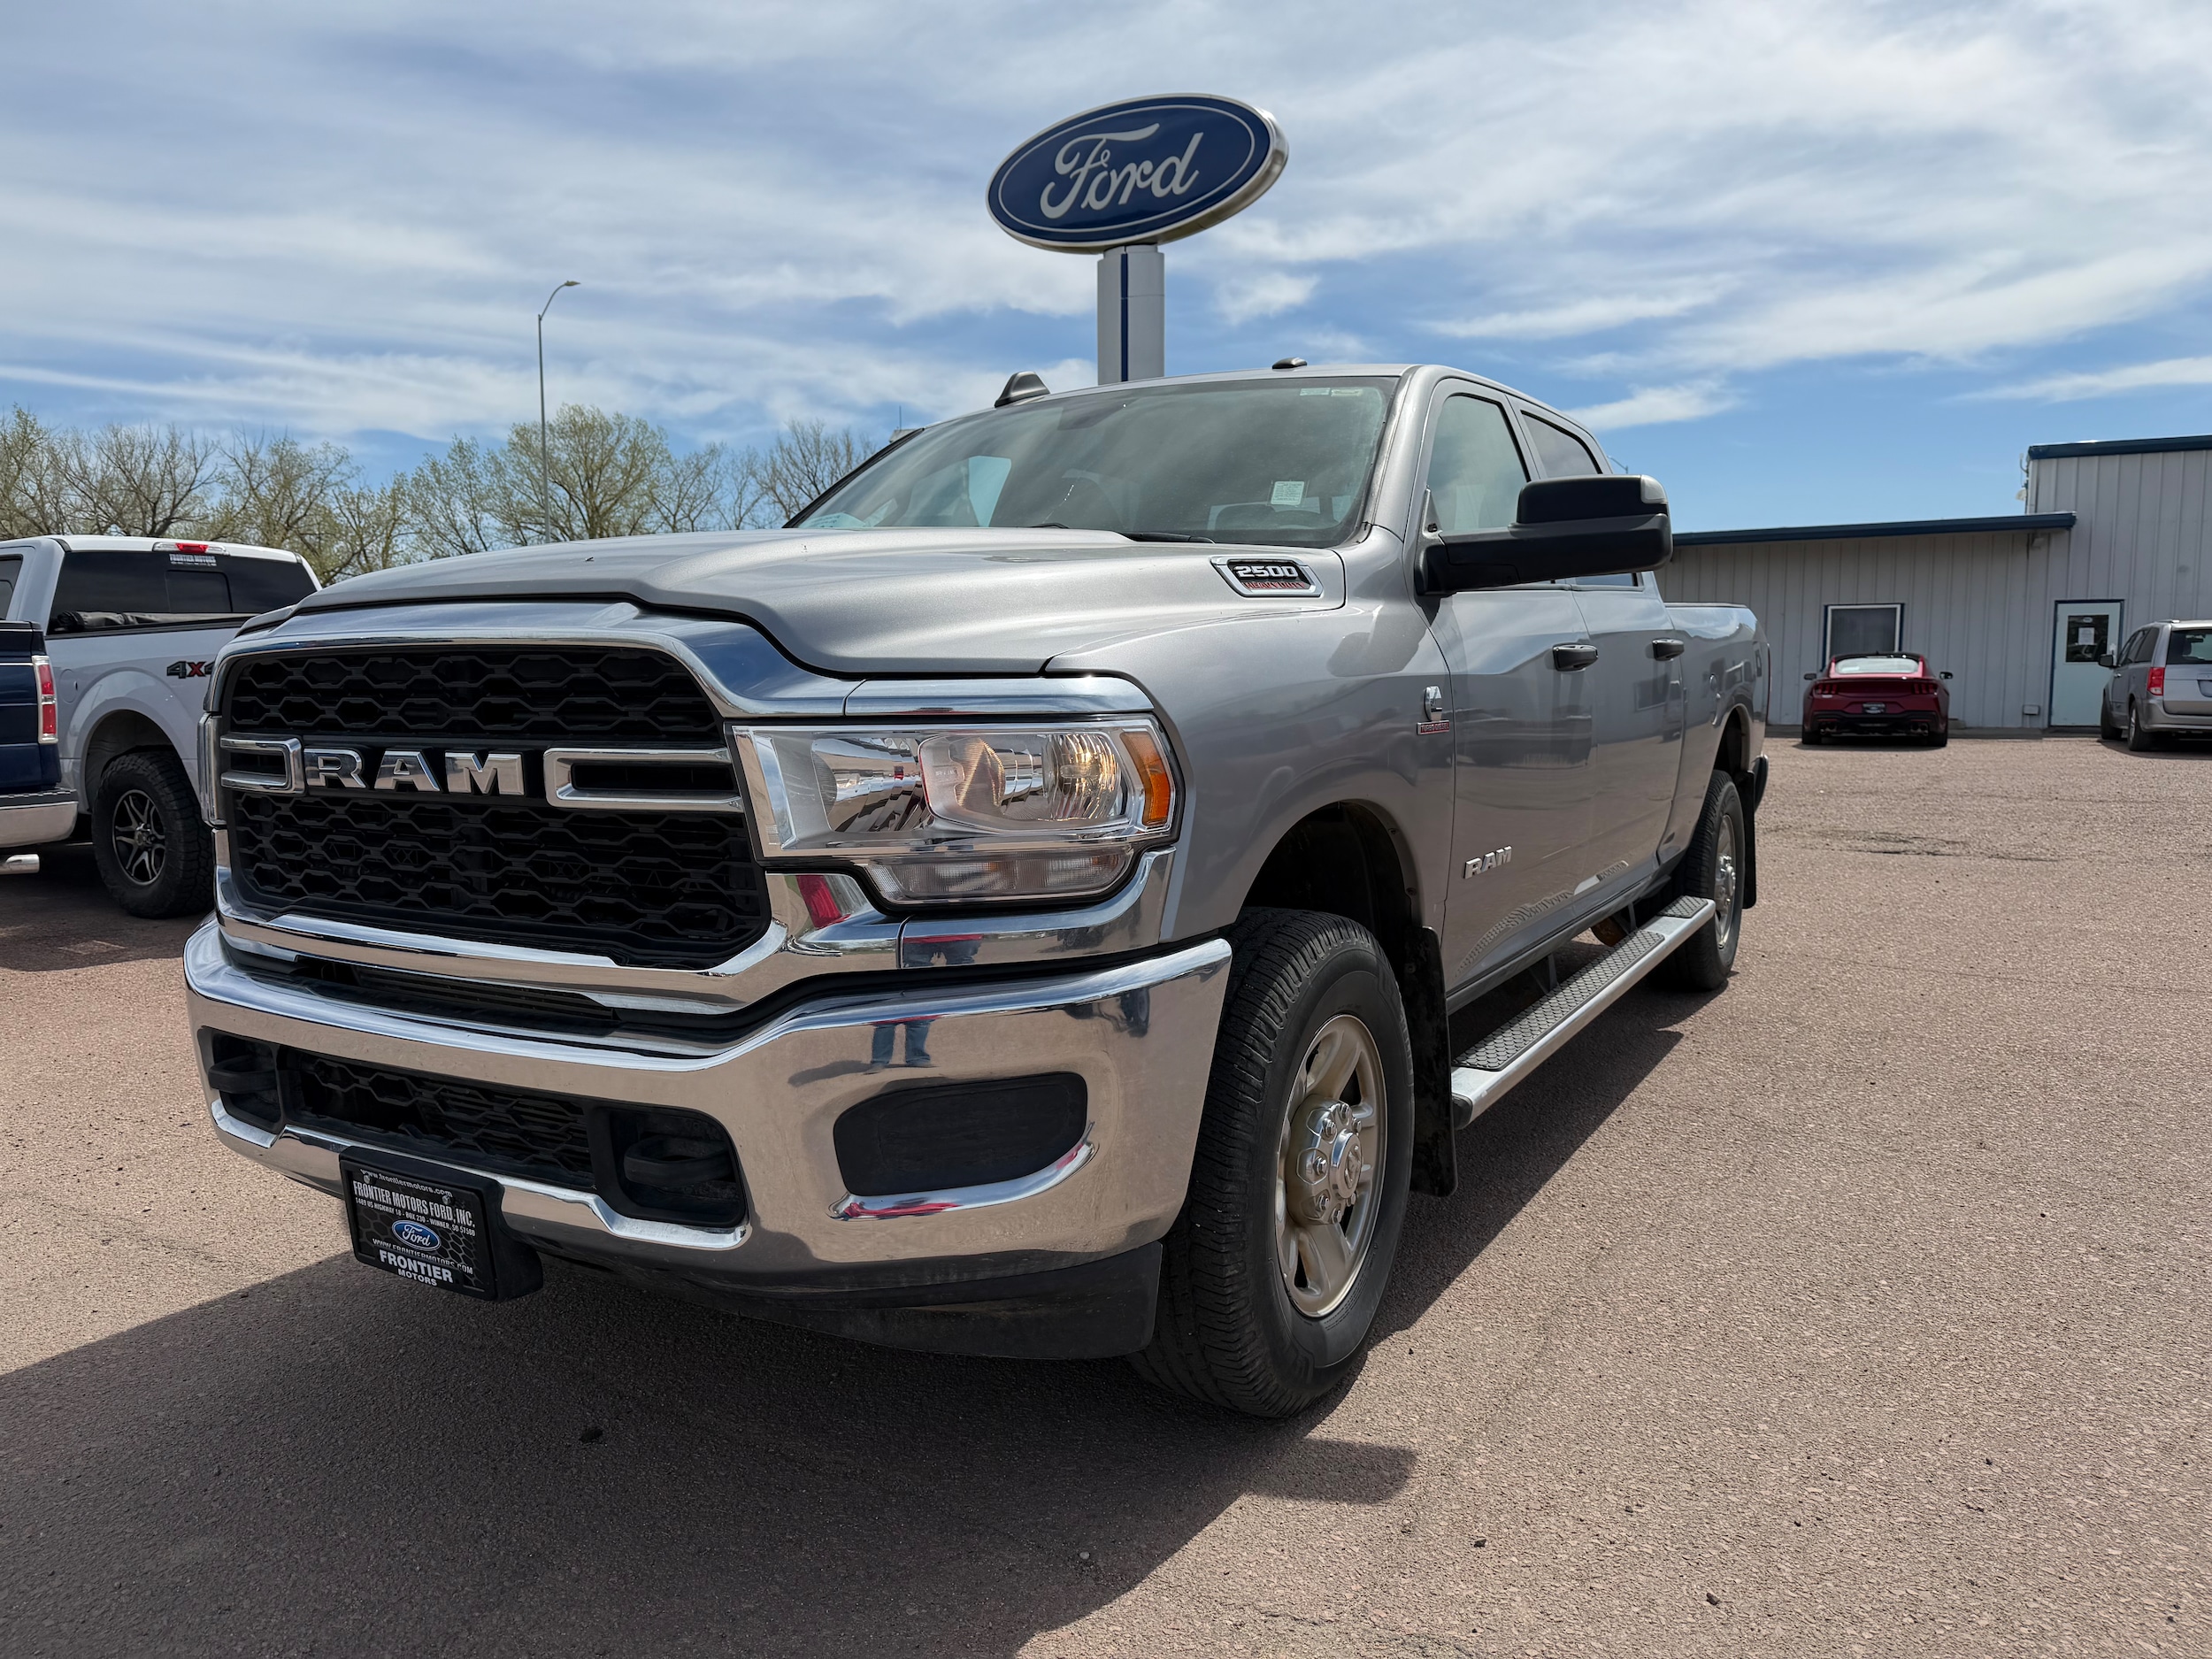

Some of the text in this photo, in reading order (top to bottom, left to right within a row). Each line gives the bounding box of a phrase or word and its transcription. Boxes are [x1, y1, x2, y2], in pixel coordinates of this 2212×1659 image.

[1040, 123, 1204, 219] Ford
[1233, 565, 1299, 579] 2500
[303, 748, 525, 796] RAM
[1463, 845, 1512, 879] RAM
[353, 1180, 393, 1205] FRONTIER
[392, 1192, 429, 1215] MOTORS
[359, 1169, 453, 1198] www.frontiermotors.com
[367, 1200, 374, 1209] US
[374, 1202, 395, 1215] HIGHWAY
[406, 1211, 416, 1220] BOX
[402, 1224, 431, 1247] Ford
[373, 1239, 473, 1274] WWWFRONTIERMOTORSCOM
[380, 1249, 454, 1283] FRONTIER
[398, 1269, 438, 1286] MOTORS
